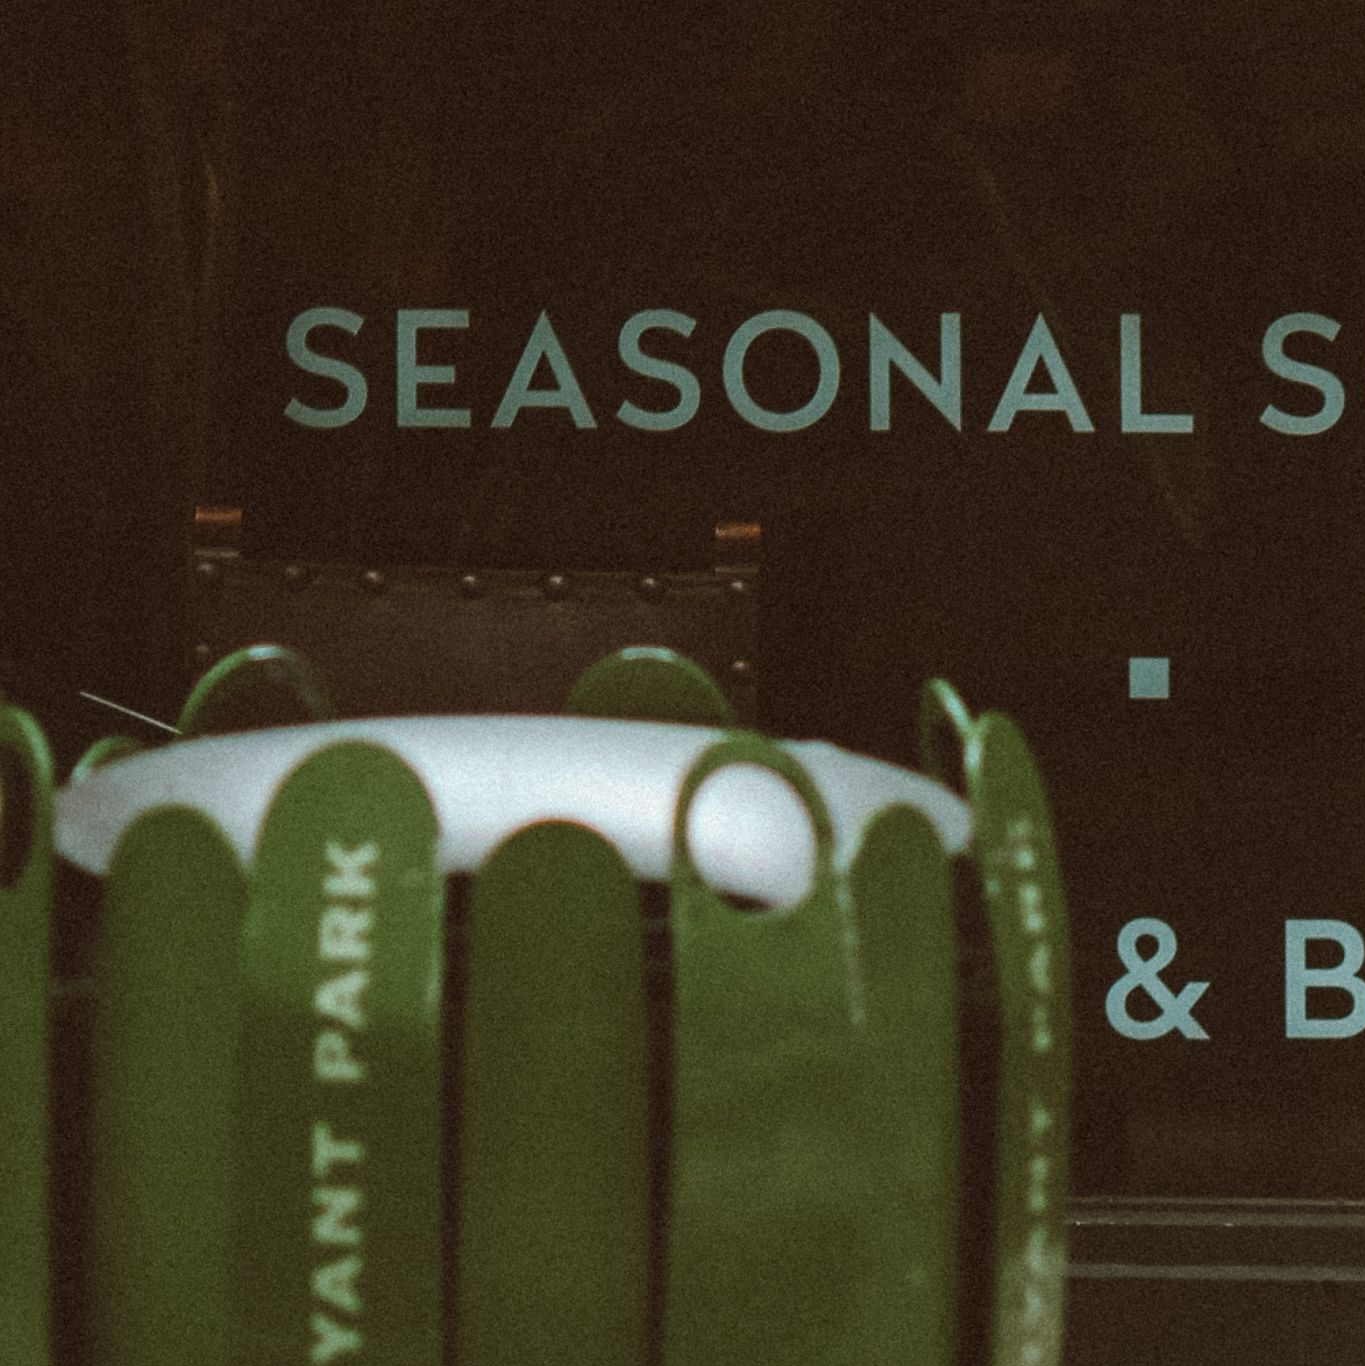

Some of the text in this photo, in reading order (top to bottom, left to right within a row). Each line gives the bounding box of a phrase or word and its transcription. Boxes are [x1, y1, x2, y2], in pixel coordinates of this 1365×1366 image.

[282, 308, 1194, 434] SEASONAL
[314, 838, 380, 1081] PARK
[1105, 918, 1210, 1040] &
